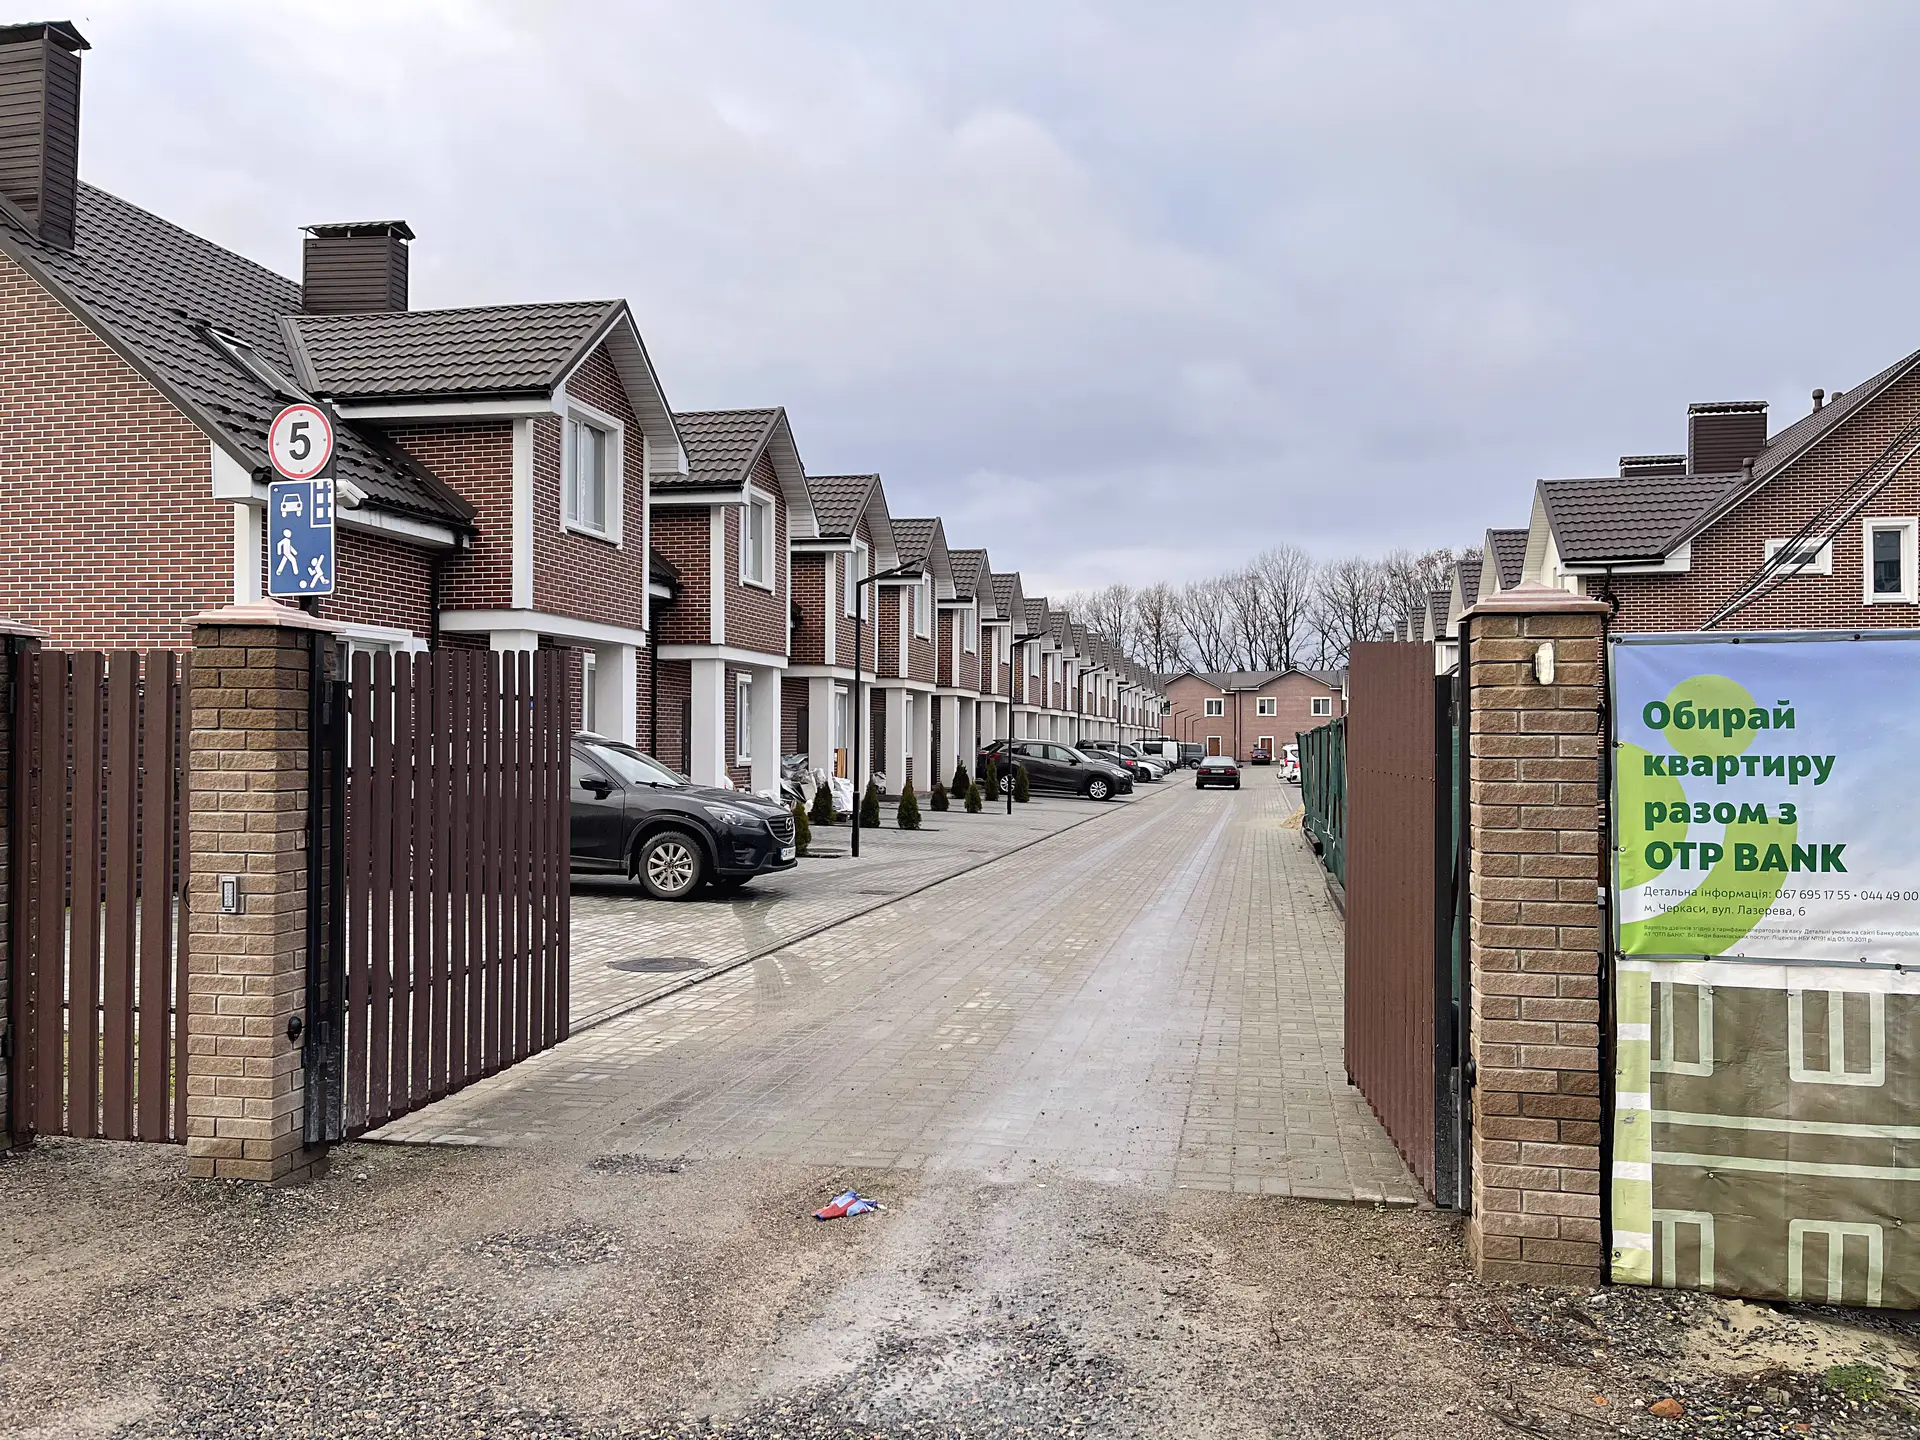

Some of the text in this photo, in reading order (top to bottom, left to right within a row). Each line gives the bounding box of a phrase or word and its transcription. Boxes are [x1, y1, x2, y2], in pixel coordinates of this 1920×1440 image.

[289, 421, 311, 461] 5
[1643, 699, 1796, 737] Обирай
[1643, 754, 1836, 786] квартиру
[1644, 801, 1798, 831] разом з
[1644, 841, 1848, 874] OTP BANK
[1643, 886, 1919, 901] Детальна інформація: 067 695 17 55 044 49 00
[1643, 903, 1806, 917] м. Черкаси, вул. Лазерева, 6
